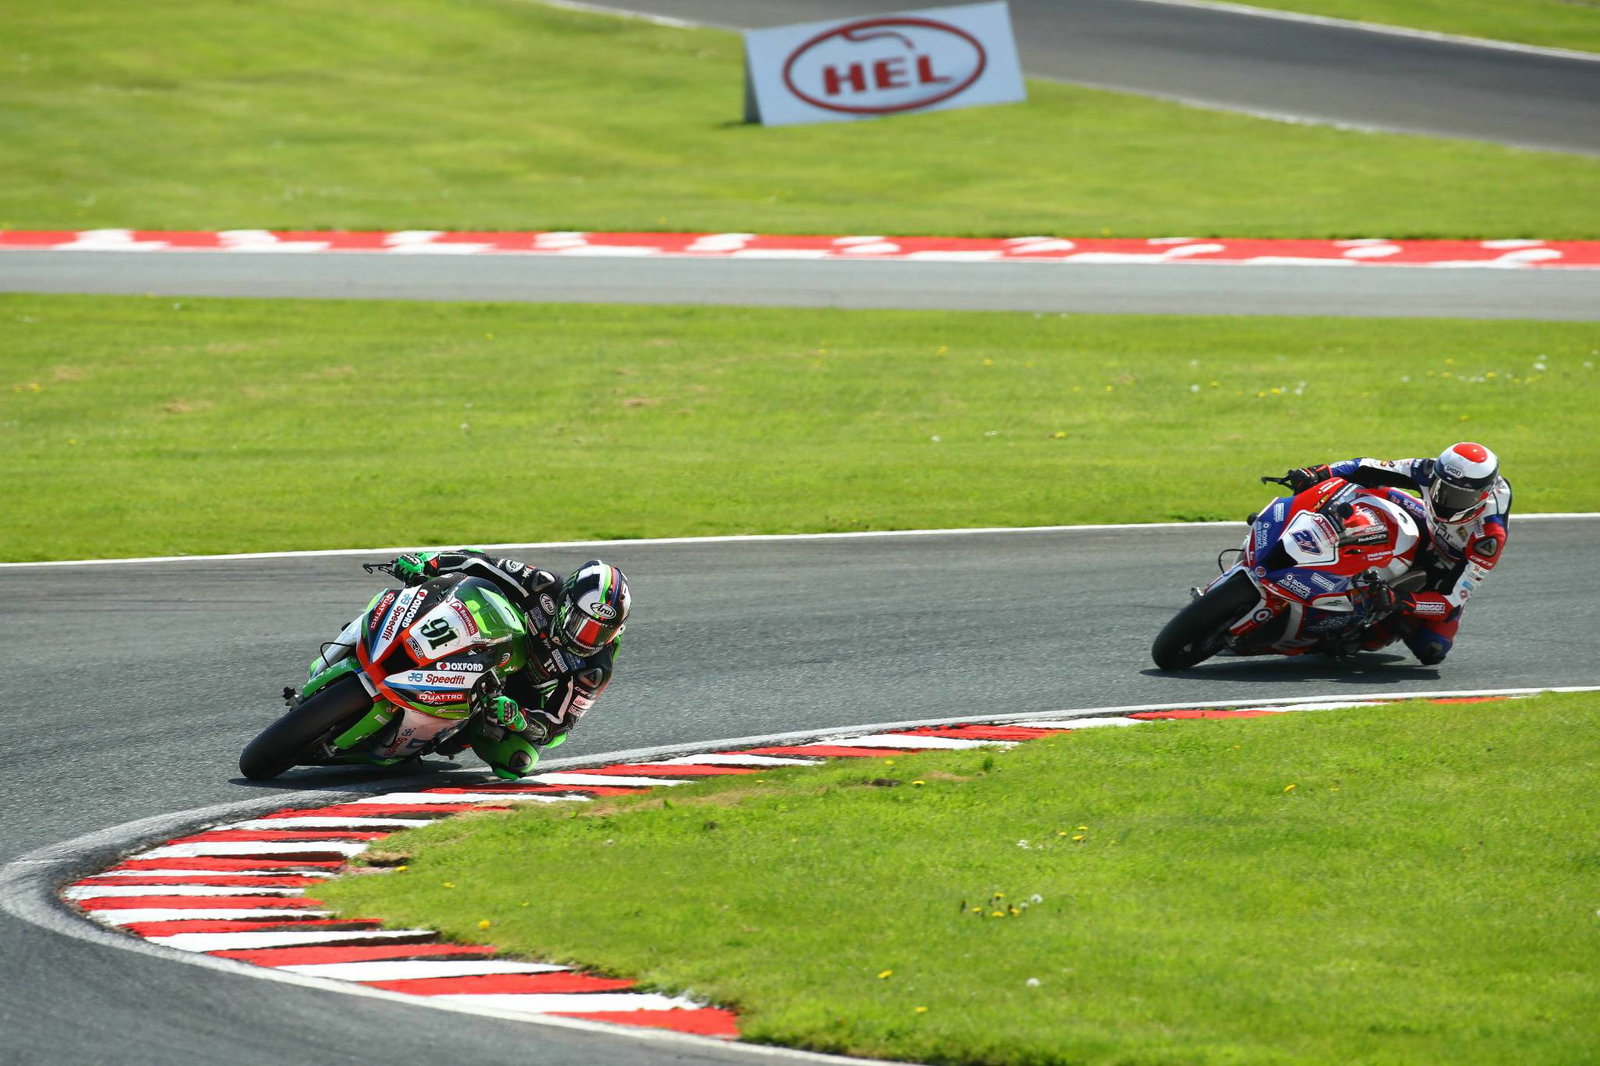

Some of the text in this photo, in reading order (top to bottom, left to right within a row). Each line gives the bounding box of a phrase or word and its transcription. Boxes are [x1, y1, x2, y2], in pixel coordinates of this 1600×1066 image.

[823, 55, 953, 96] HEL
[1446, 465, 1462, 477] SHOEI
[1279, 579, 1290, 588] AIR
[1289, 584, 1310, 600] FORCE
[1291, 579, 1311, 593] ROYAL
[370, 592, 396, 629] QUATTRO
[402, 599, 422, 628] OXFORD
[592, 604, 615, 617] Arai
[1416, 604, 1443, 612] BRIGGS
[382, 605, 405, 641] Speedfit
[460, 608, 475, 635] Bennetts
[418, 616, 458, 651] 91
[450, 662, 484, 672] OXFORD
[425, 673, 466, 685] Speedfit
[418, 691, 463, 703] QUATTRO
